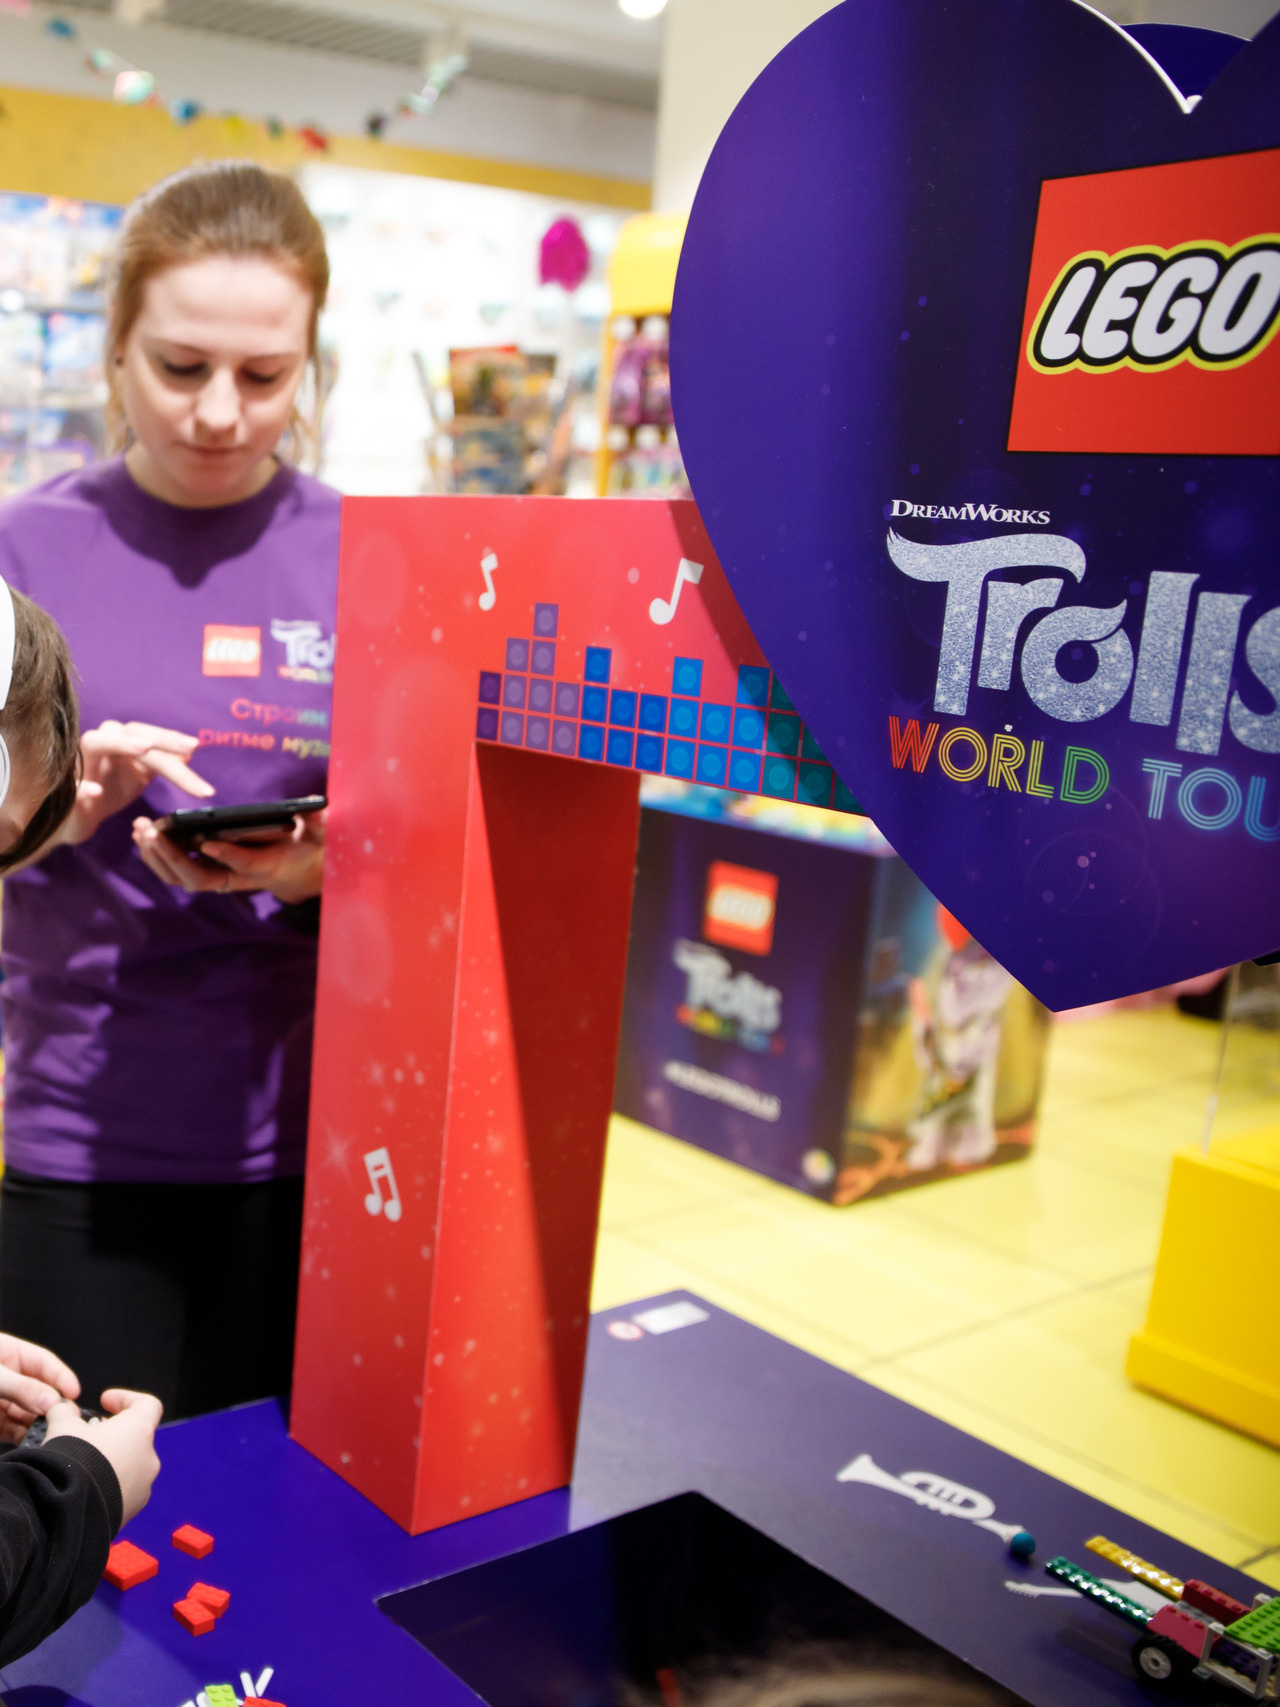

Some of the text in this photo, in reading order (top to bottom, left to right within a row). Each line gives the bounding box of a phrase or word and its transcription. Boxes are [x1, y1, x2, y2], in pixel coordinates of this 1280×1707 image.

[1032, 239, 1280, 368] LEGO
[886, 526, 1280, 756] Trolls
[889, 716, 1110, 804] WORLD
